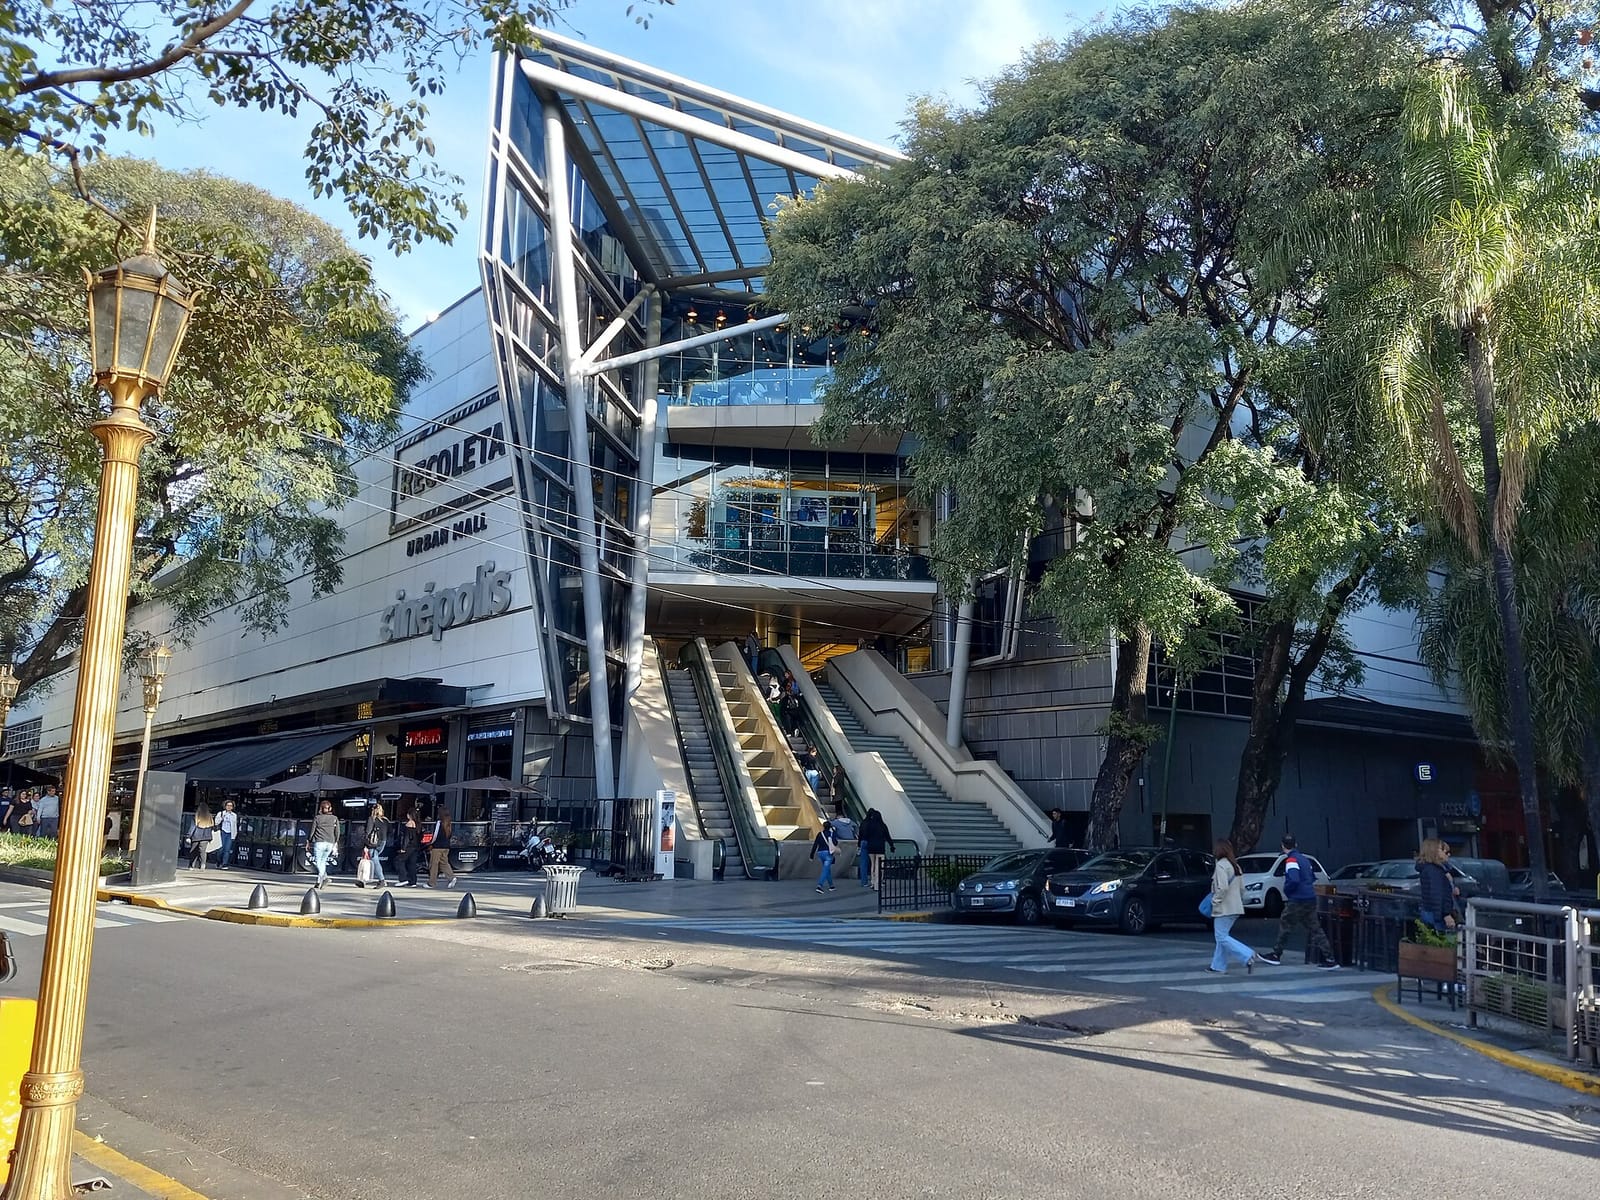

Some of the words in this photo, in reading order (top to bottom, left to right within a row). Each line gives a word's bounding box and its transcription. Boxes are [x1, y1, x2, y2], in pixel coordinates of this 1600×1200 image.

[400, 421, 506, 501] RECOLETA
[407, 526, 449, 557] URBAN
[451, 512, 488, 541] MALL
